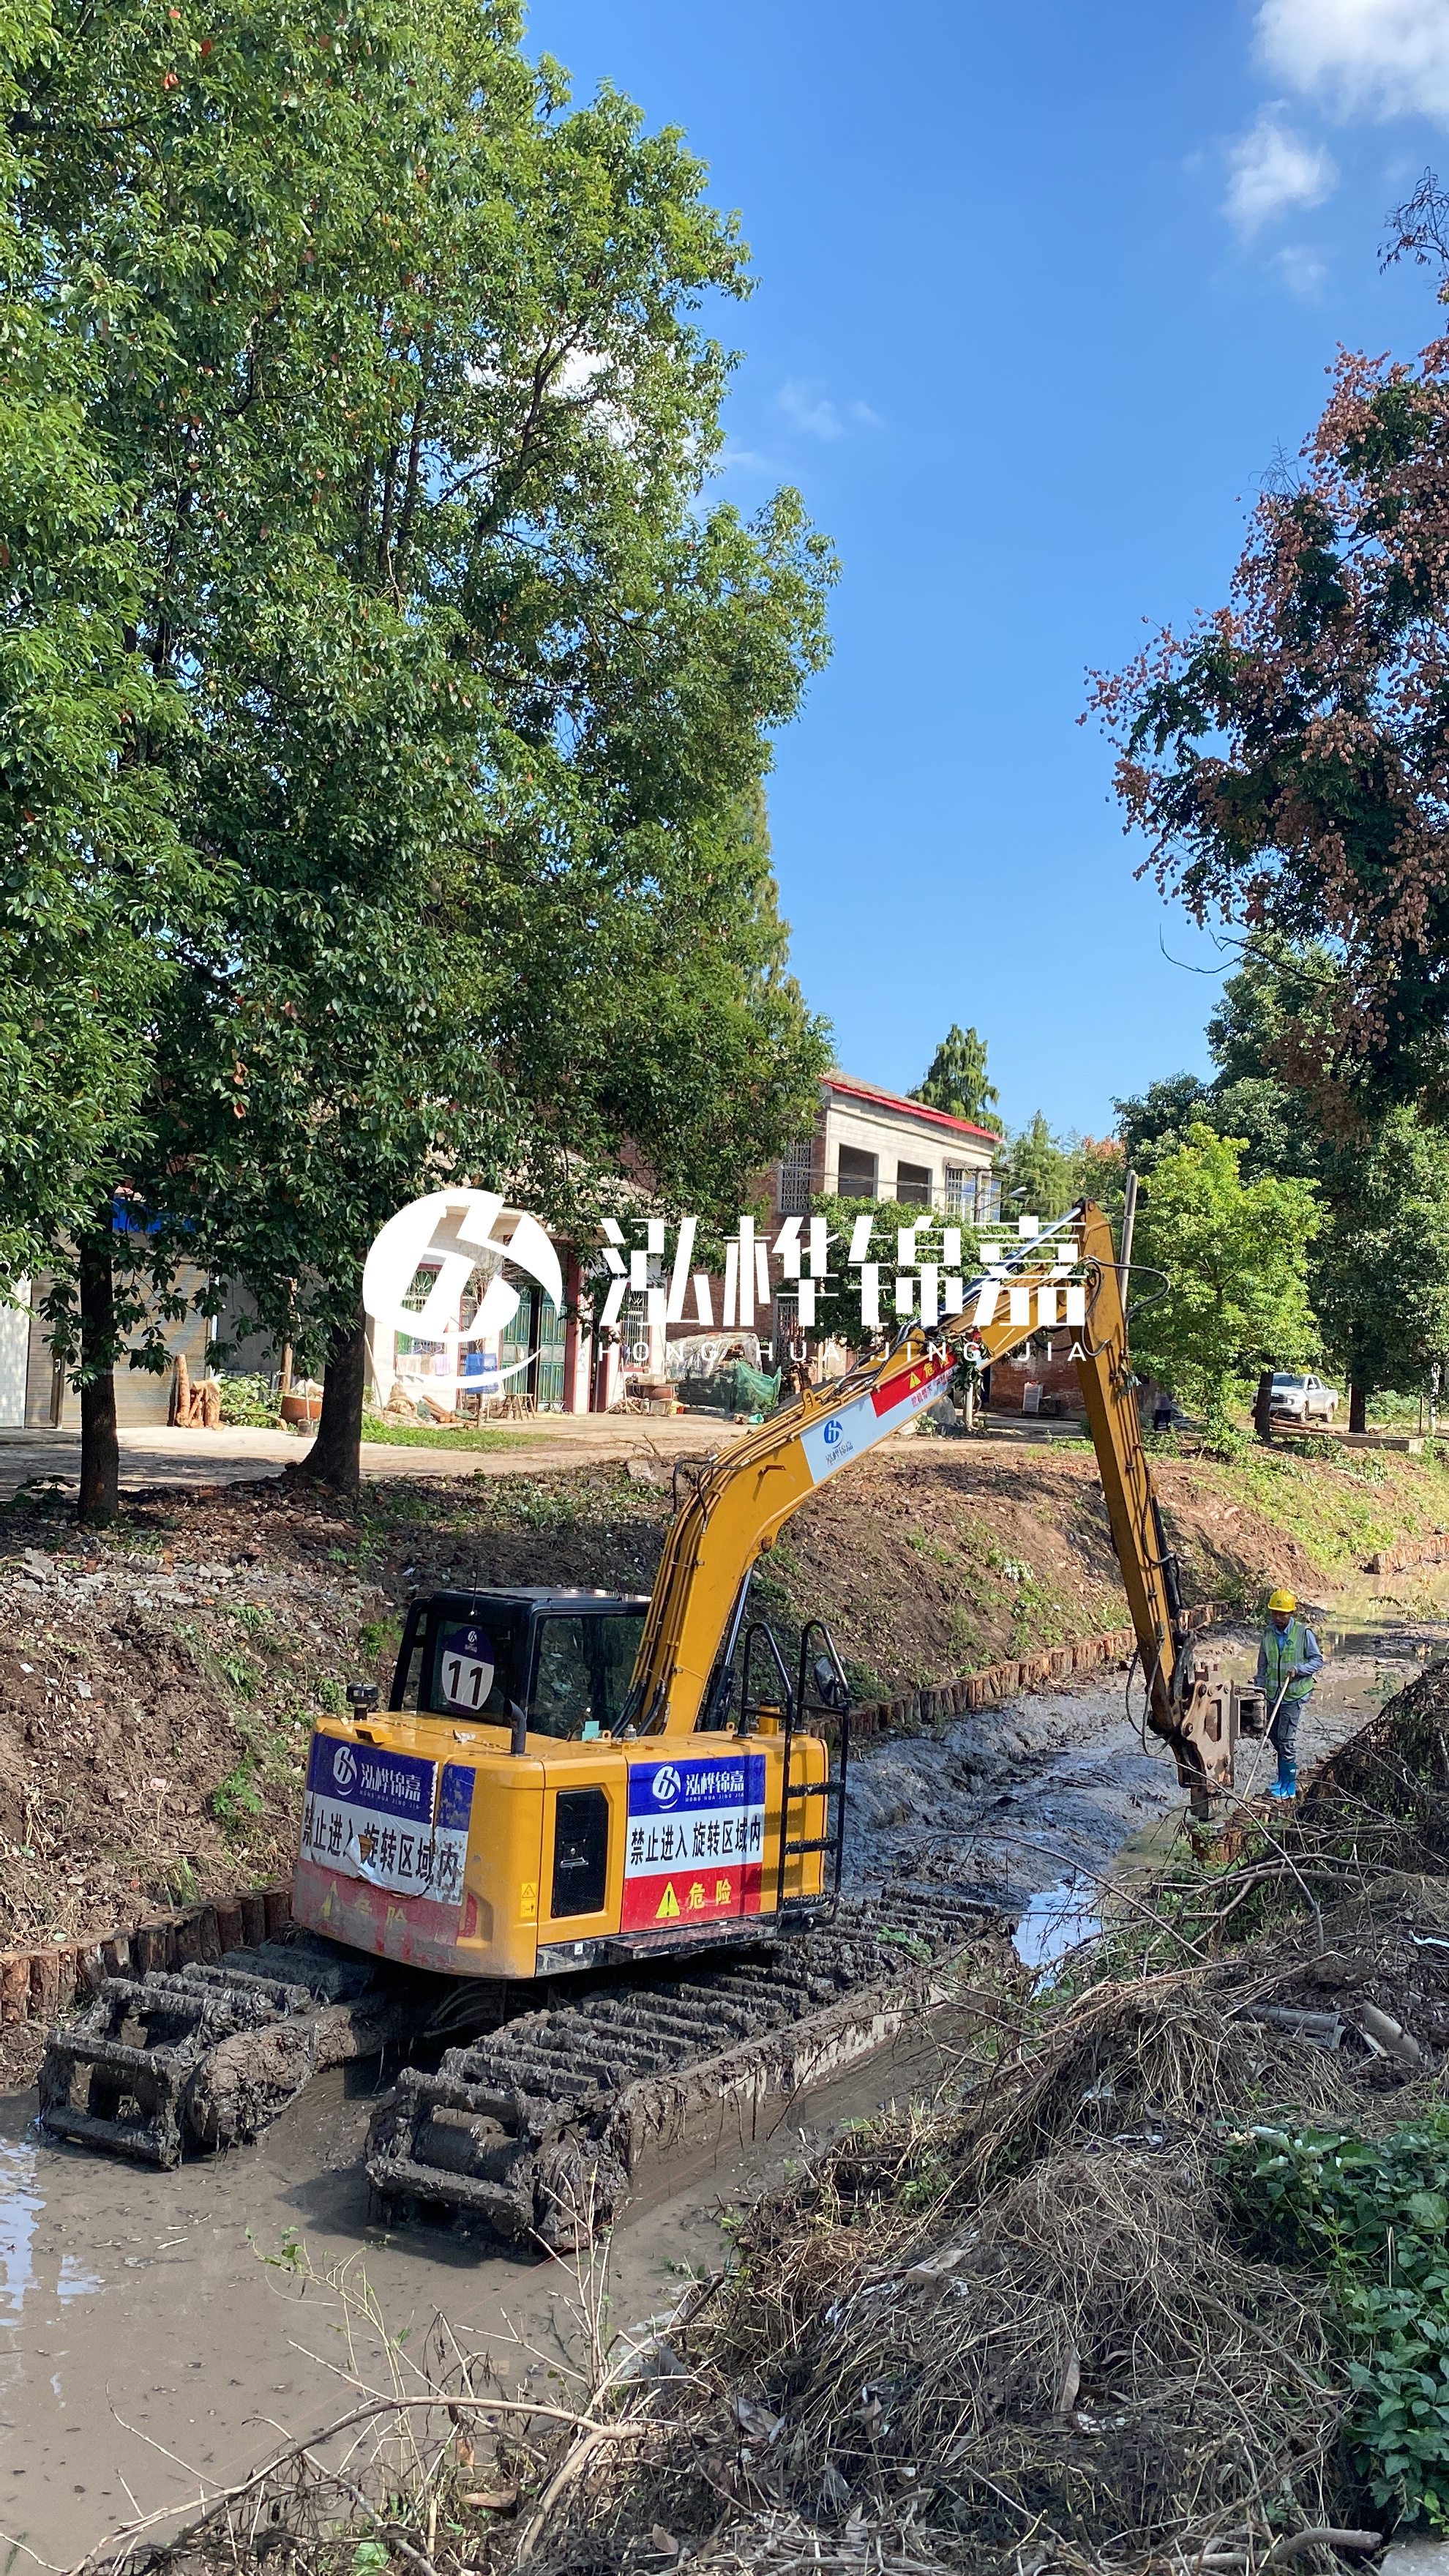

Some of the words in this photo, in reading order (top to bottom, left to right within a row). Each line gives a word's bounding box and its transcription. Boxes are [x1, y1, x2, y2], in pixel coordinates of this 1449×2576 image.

[449, 1660, 483, 1706] 11
[361, 1763, 422, 1802] 泓桦锦嘉
[685, 1770, 744, 1796] 泓桦锦嘉
[689, 1878, 732, 1910] 危险
